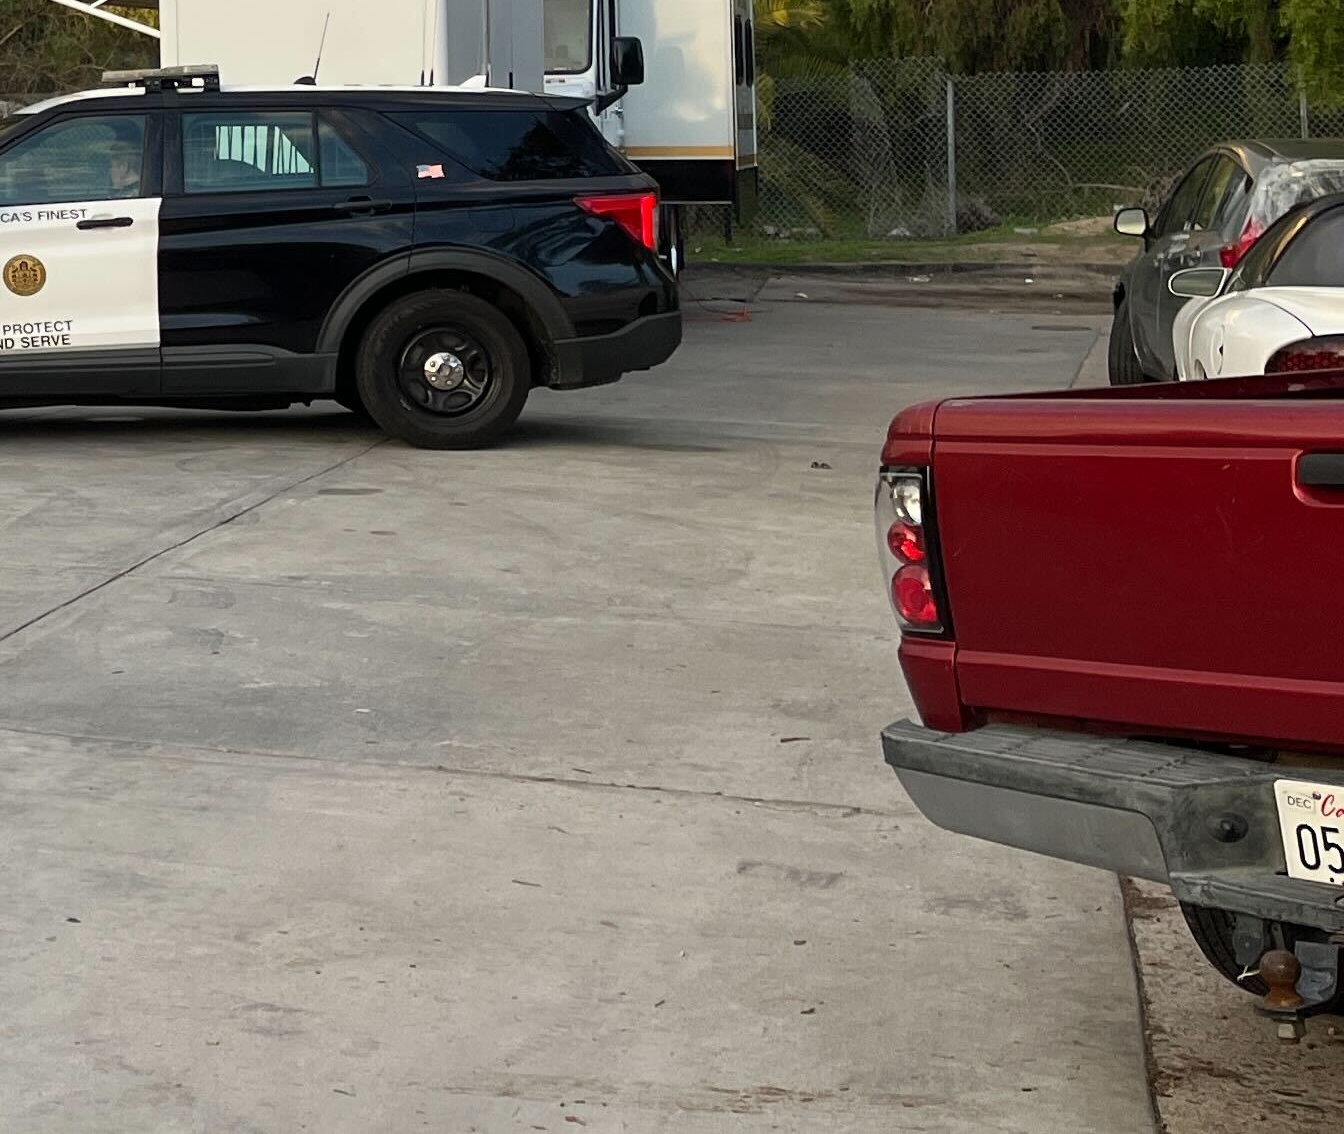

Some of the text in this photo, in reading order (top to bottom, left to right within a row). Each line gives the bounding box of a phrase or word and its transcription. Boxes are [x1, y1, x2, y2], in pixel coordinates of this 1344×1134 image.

[38, 208, 88, 221] FINEST
[3, 320, 74, 335] PROTECT
[20, 334, 72, 348] SERVE
[1287, 795, 1313, 809] DEC
[1296, 824, 1344, 874] 05
